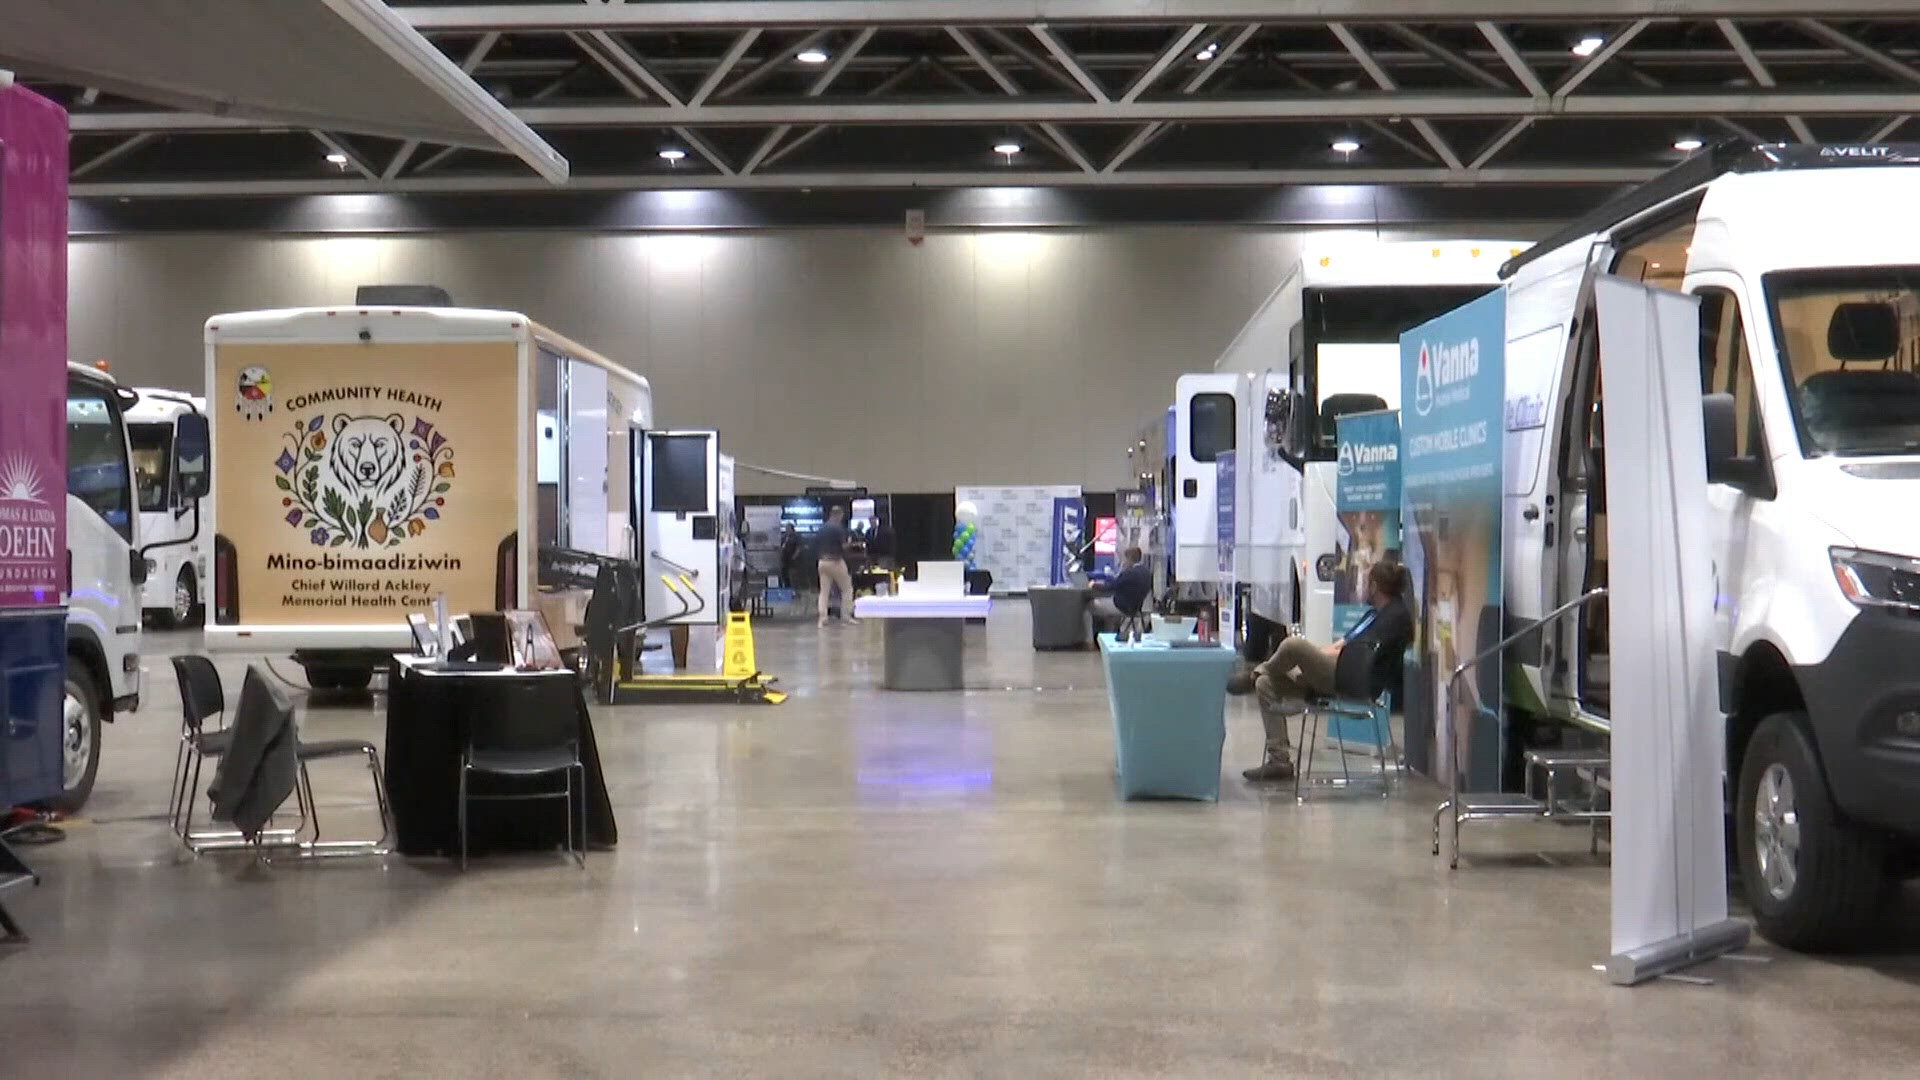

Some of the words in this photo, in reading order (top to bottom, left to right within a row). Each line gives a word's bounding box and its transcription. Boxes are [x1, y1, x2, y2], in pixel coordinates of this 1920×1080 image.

[1432, 337, 1479, 388] Vanna
[286, 386, 382, 412] COMMUNITY
[387, 388, 443, 413] HEALTH
[1460, 420, 1488, 448] CLINICS
[1354, 443, 1398, 465] Vanna
[30, 507, 56, 523] LINDA
[267, 553, 461, 571] Mino-bimaadiziwin
[291, 579, 326, 592] Chief
[330, 579, 380, 592] Willard
[385, 579, 431, 594] Ackley
[282, 595, 347, 607] Memorial
[351, 595, 396, 607] Health
[401, 596, 437, 607] Cent
